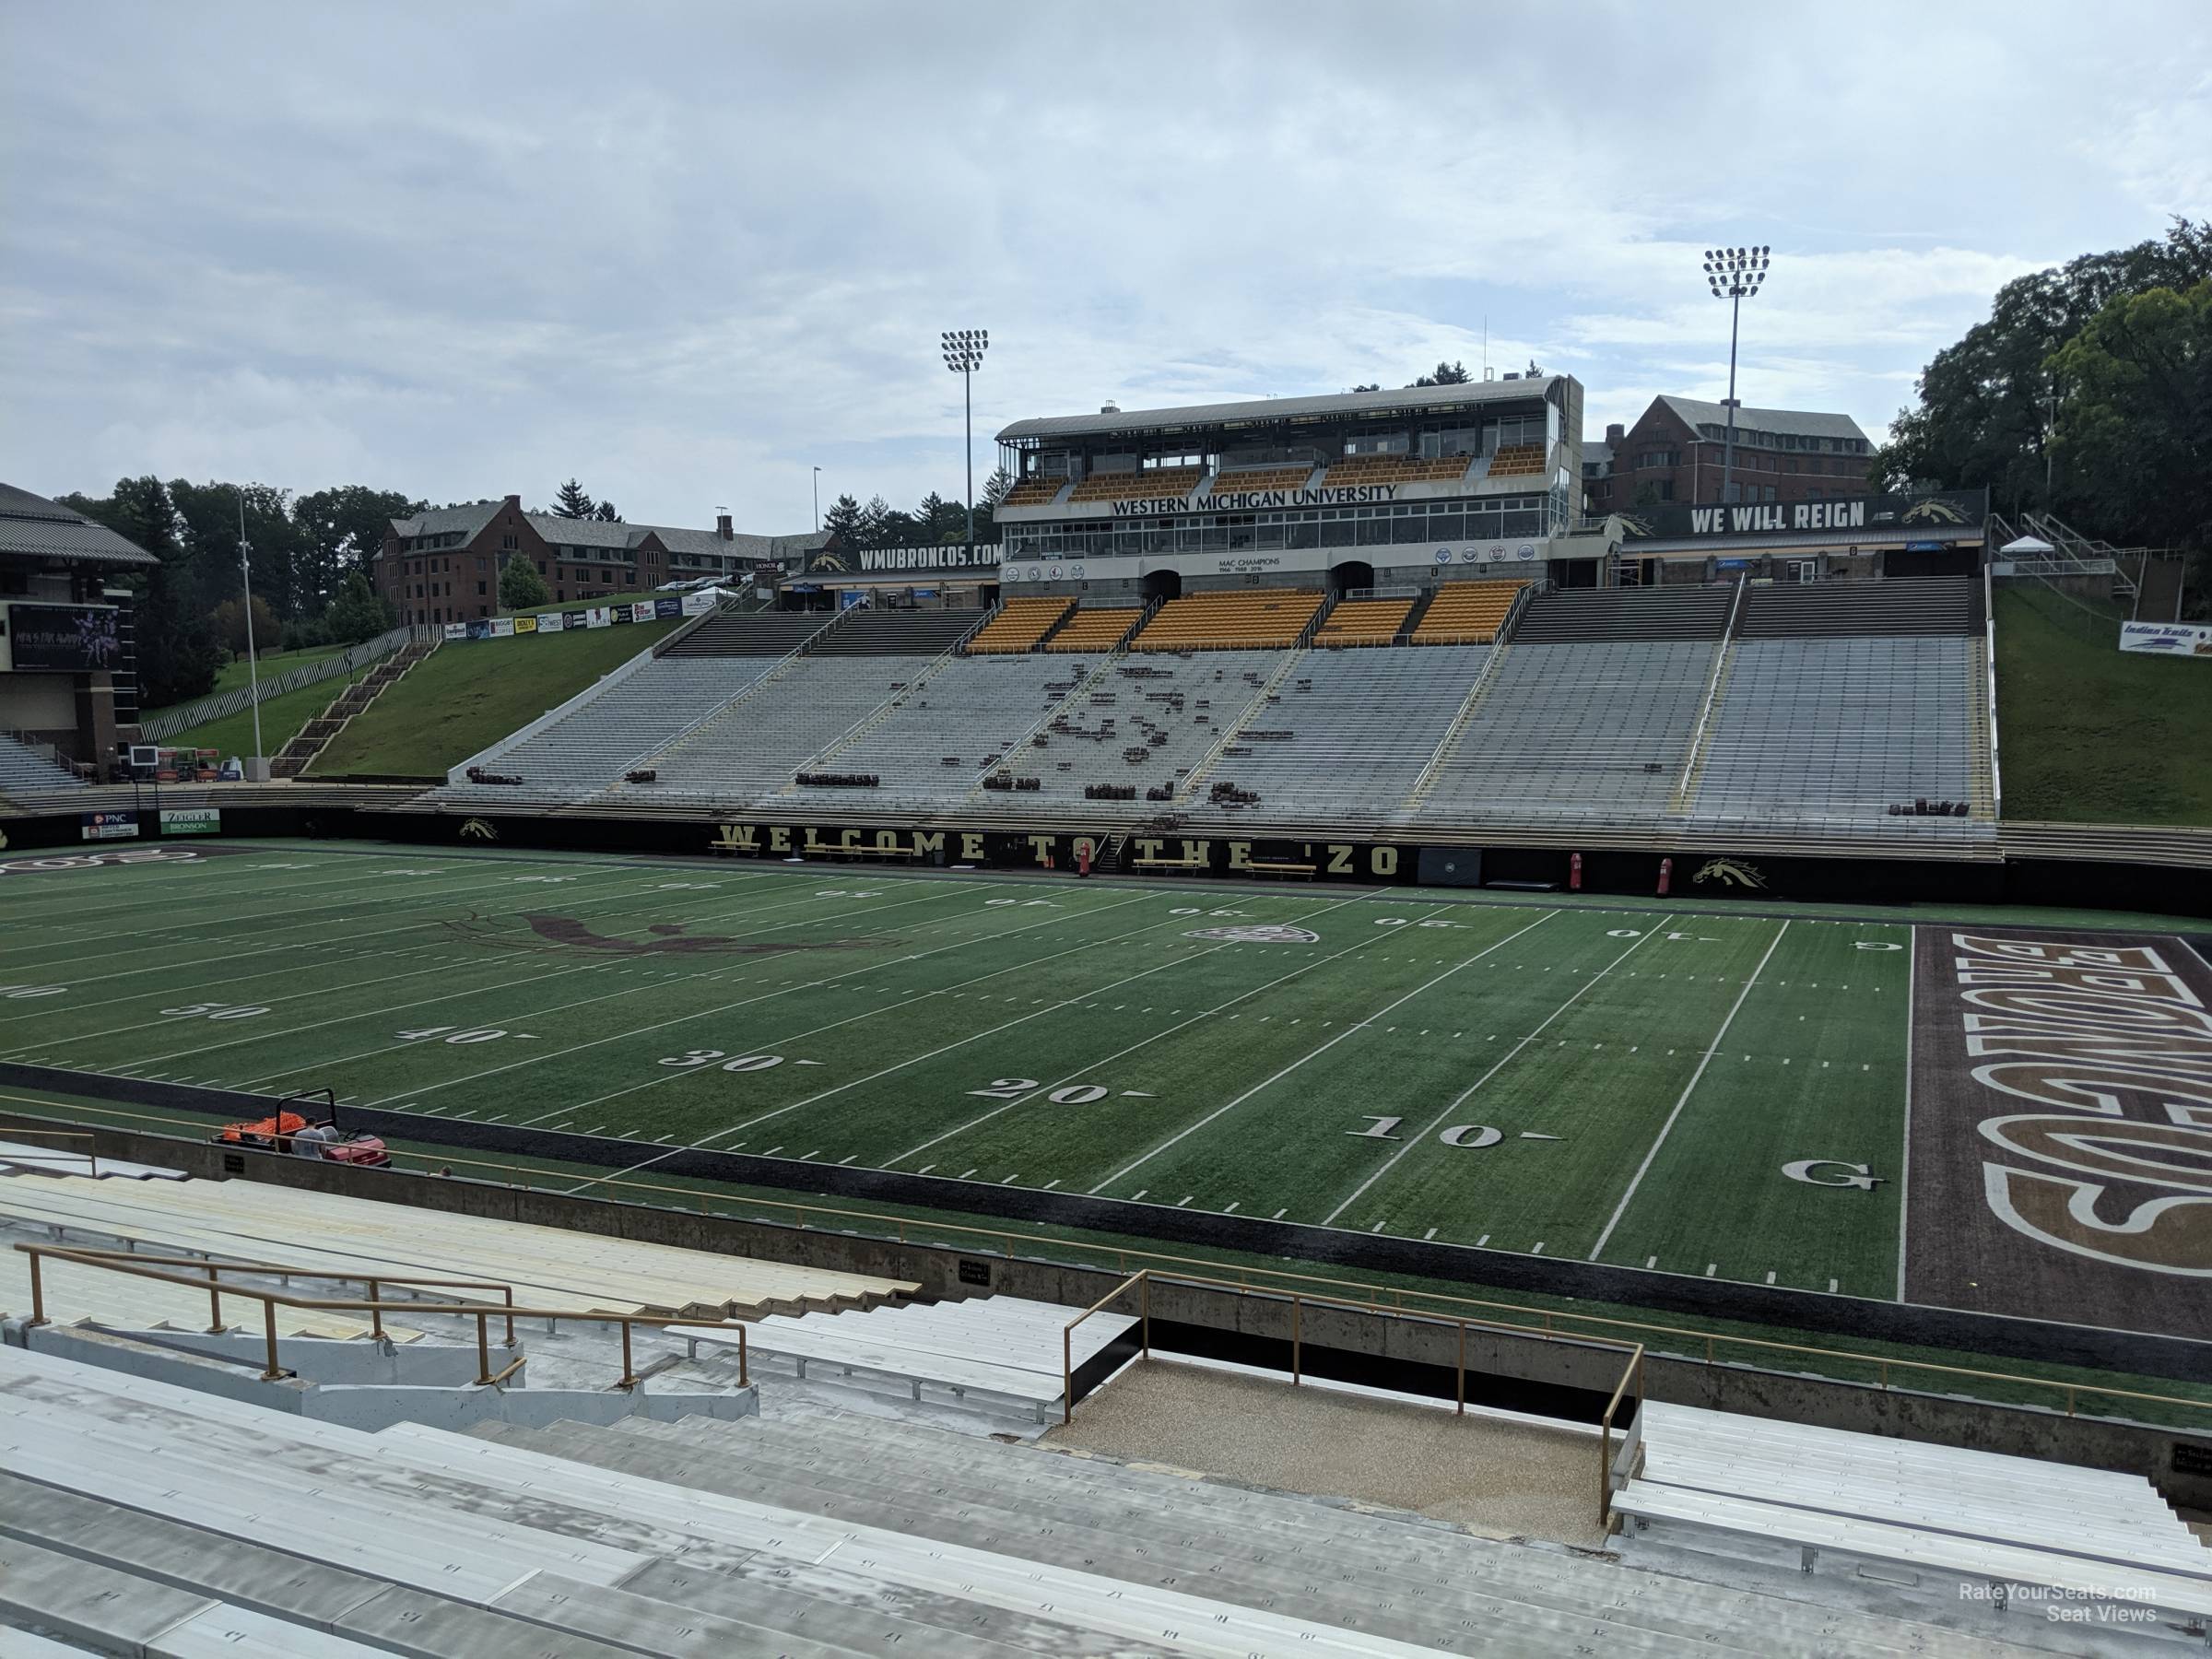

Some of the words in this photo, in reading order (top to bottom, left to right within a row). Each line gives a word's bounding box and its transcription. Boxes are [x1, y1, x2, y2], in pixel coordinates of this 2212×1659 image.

[1112, 496, 1189, 516] WESTERN
[1196, 490, 1285, 511] MICHIGAN
[1292, 485, 1397, 505] UNIVERSITY
[1691, 508, 1724, 534] WE
[1732, 505, 1786, 532] WILL
[1794, 501, 1865, 528] REIGN
[860, 543, 1004, 571] WMUBRONCOS.COM
[1238, 558, 1280, 567] CHAMPIONS
[2124, 625, 2161, 635] Indian
[2161, 627, 2194, 637] Trails
[105, 814, 126, 823] PNC
[168, 811, 211, 822] ZEIGLER
[720, 825, 984, 859] WELCOME
[1028, 835, 1096, 864] TO
[1135, 839, 1252, 869] THE
[393, 1025, 509, 1045] 40
[657, 1049, 785, 1073] 30
[966, 1077, 1109, 1105] 20
[1345, 1115, 1503, 1147] 10
[1781, 1159, 1891, 1191] G
